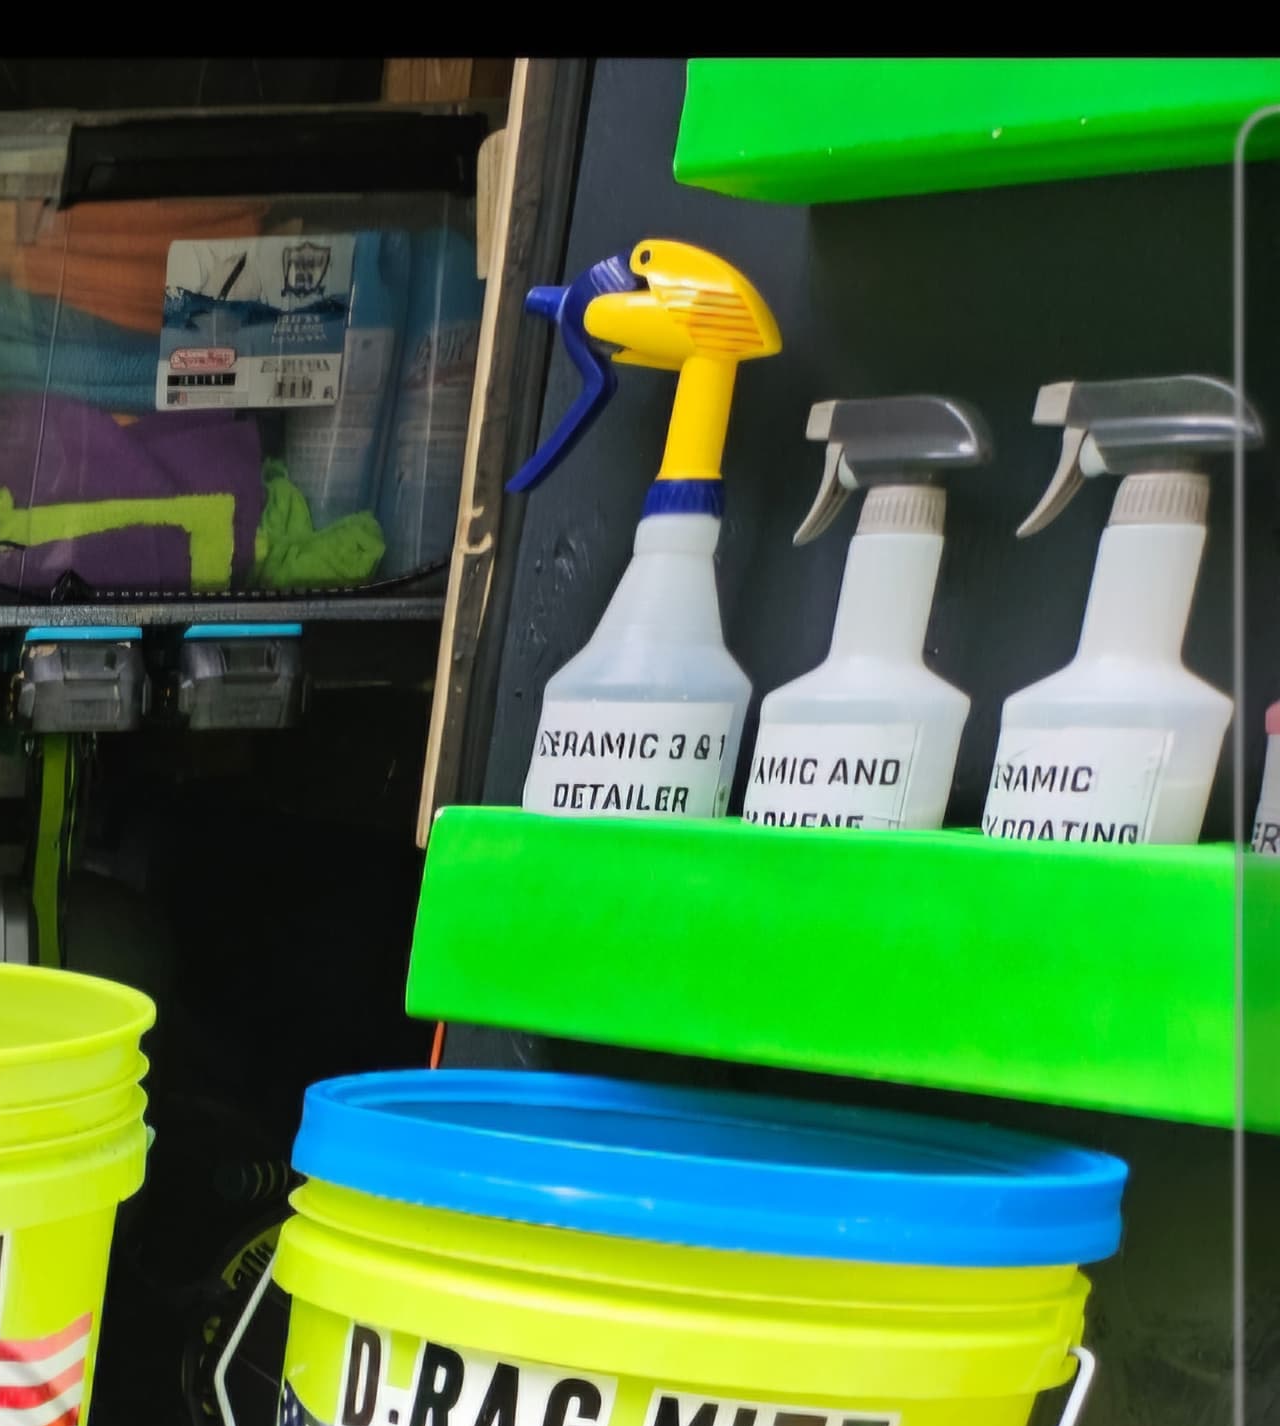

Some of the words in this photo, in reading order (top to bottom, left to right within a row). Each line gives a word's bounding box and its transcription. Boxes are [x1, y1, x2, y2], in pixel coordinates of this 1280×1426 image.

[668, 733, 687, 760] 3
[827, 757, 901, 786] AND
[553, 783, 690, 814] DETAILER
